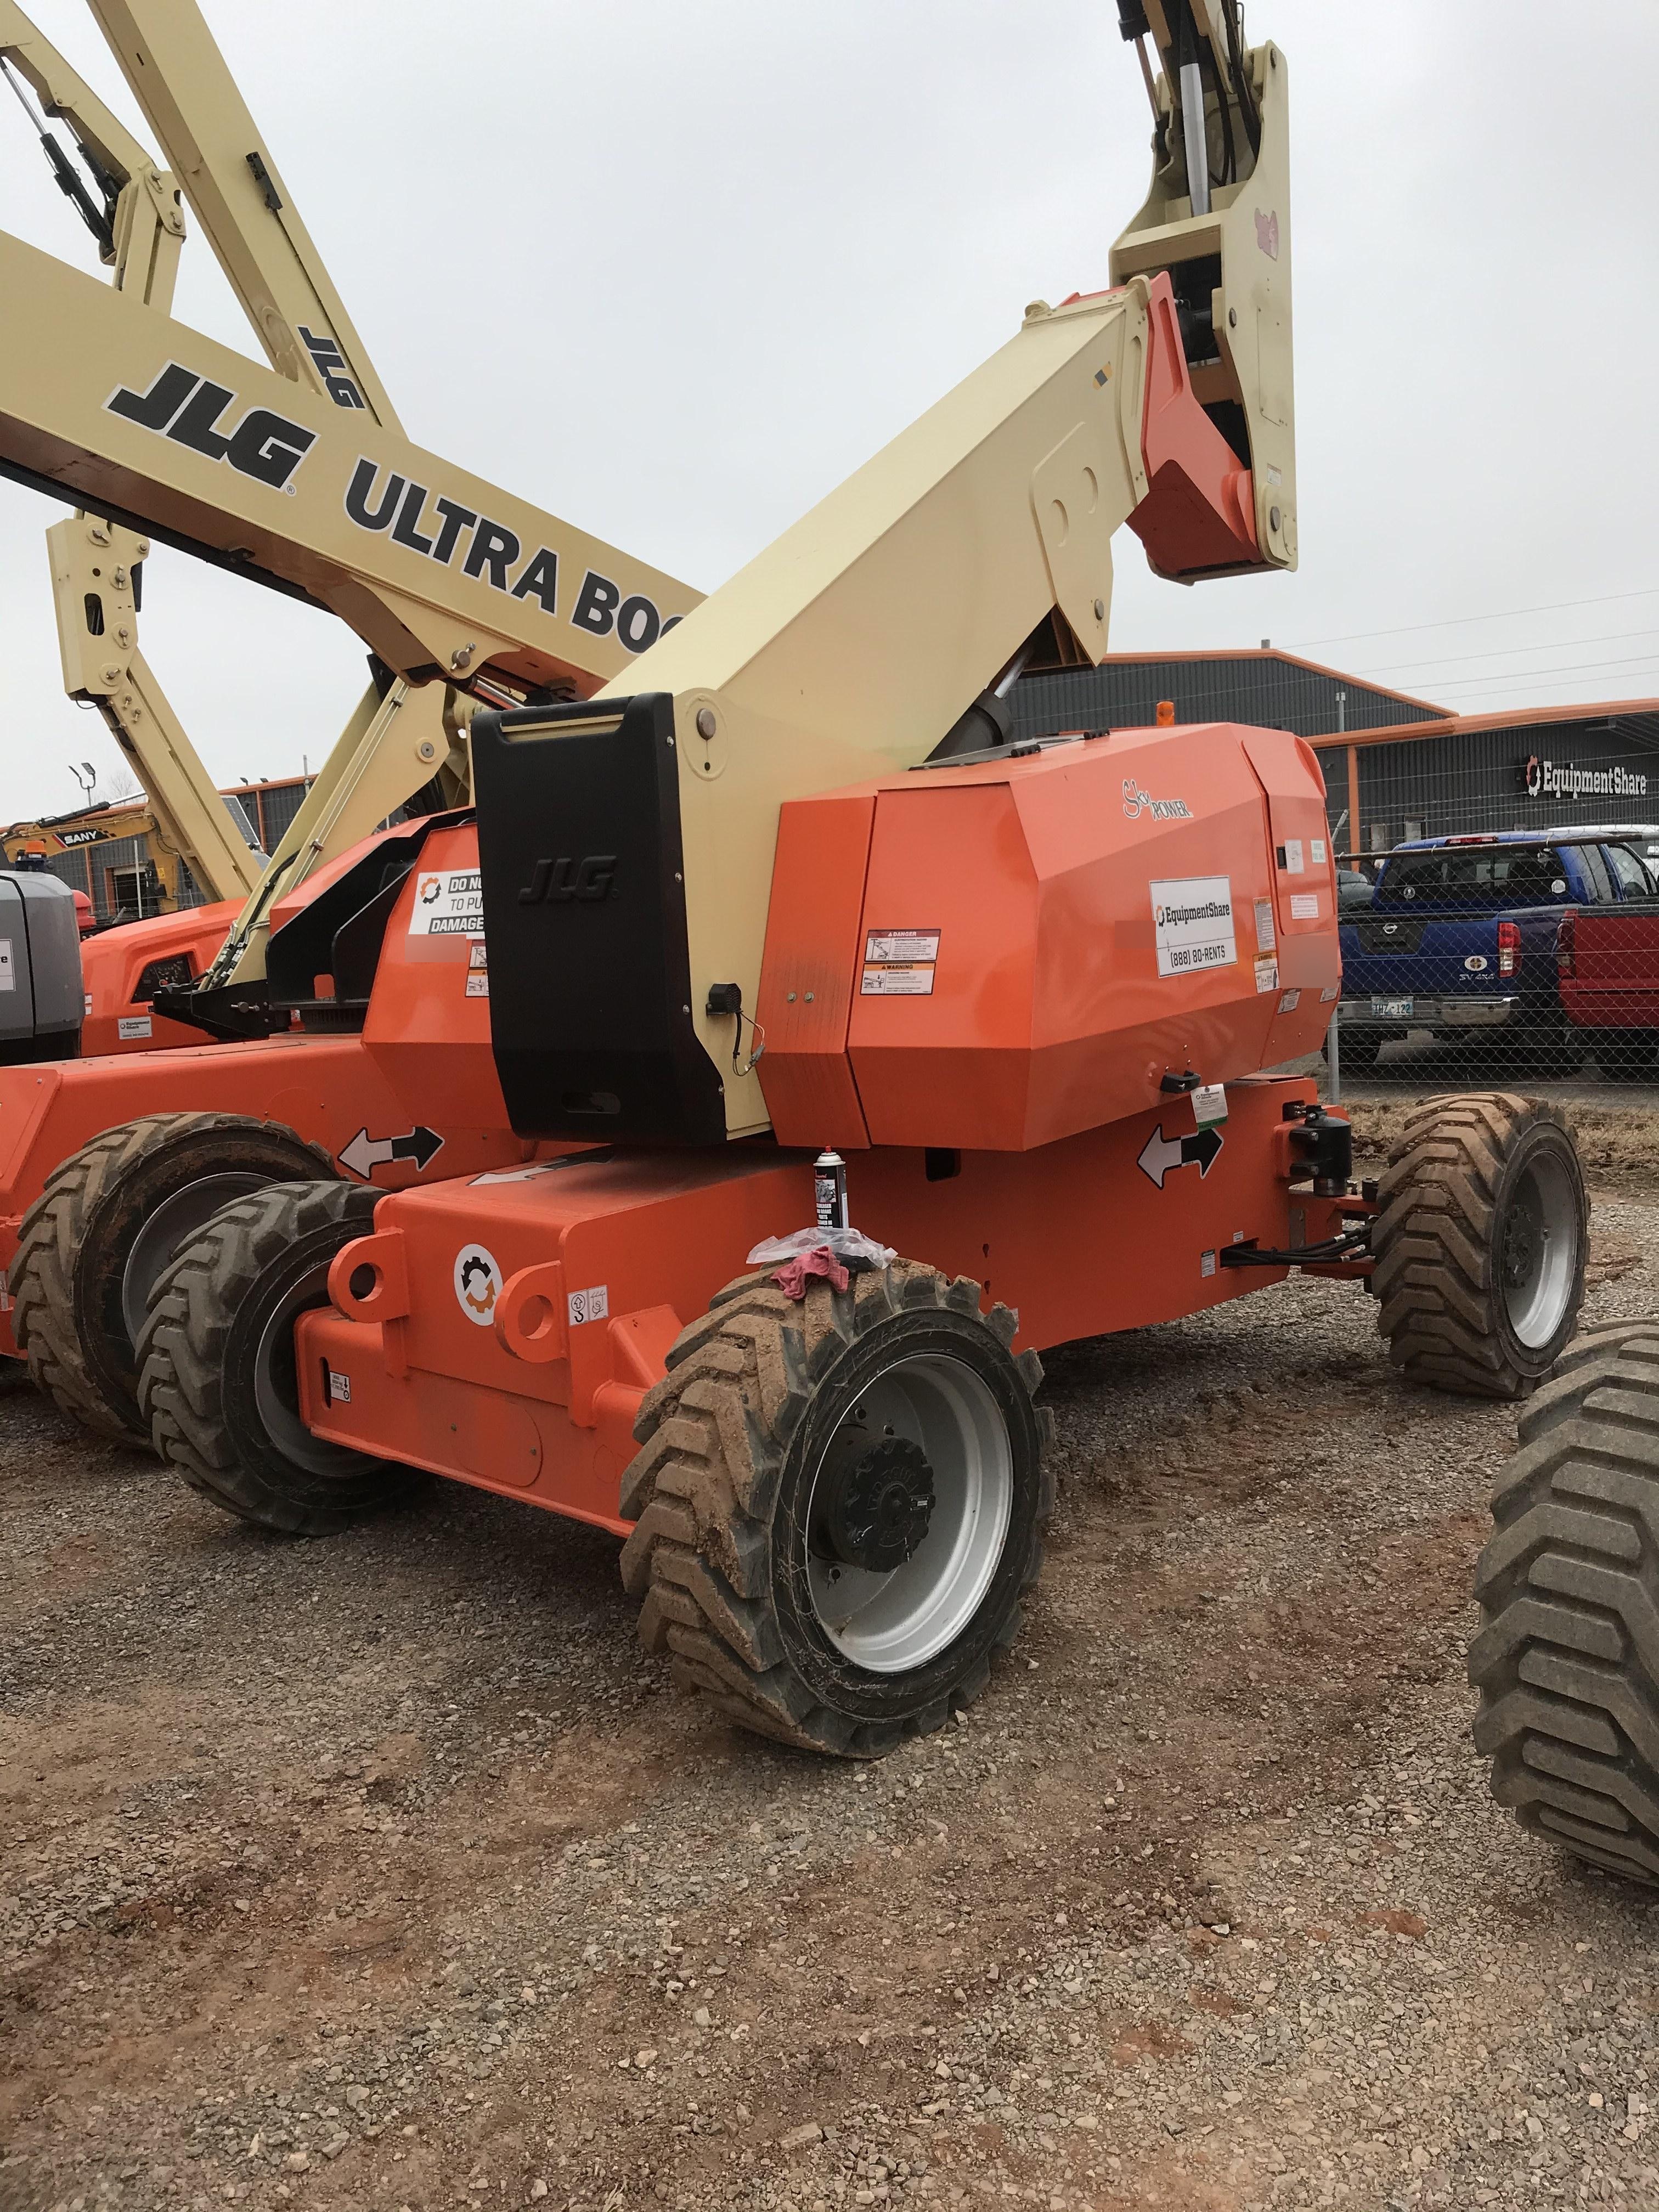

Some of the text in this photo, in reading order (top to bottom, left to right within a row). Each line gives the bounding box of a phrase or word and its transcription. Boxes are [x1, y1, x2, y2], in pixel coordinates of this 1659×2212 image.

[297, 325, 366, 409] JLG
[104, 361, 685, 654] JLG ULTRA BO
[1543, 760, 1646, 799] EquipmentShare
[1151, 800, 1192, 820] POWER
[64, 830, 97, 844] SANY
[450, 878, 467, 891] DO
[518, 856, 618, 903] JLG
[451, 898, 464, 911] TO
[1165, 901, 1230, 926] EquipmentShare
[431, 917, 484, 932] DAMAGE
[1170, 945, 1226, 968] (888) 80-RENTS
